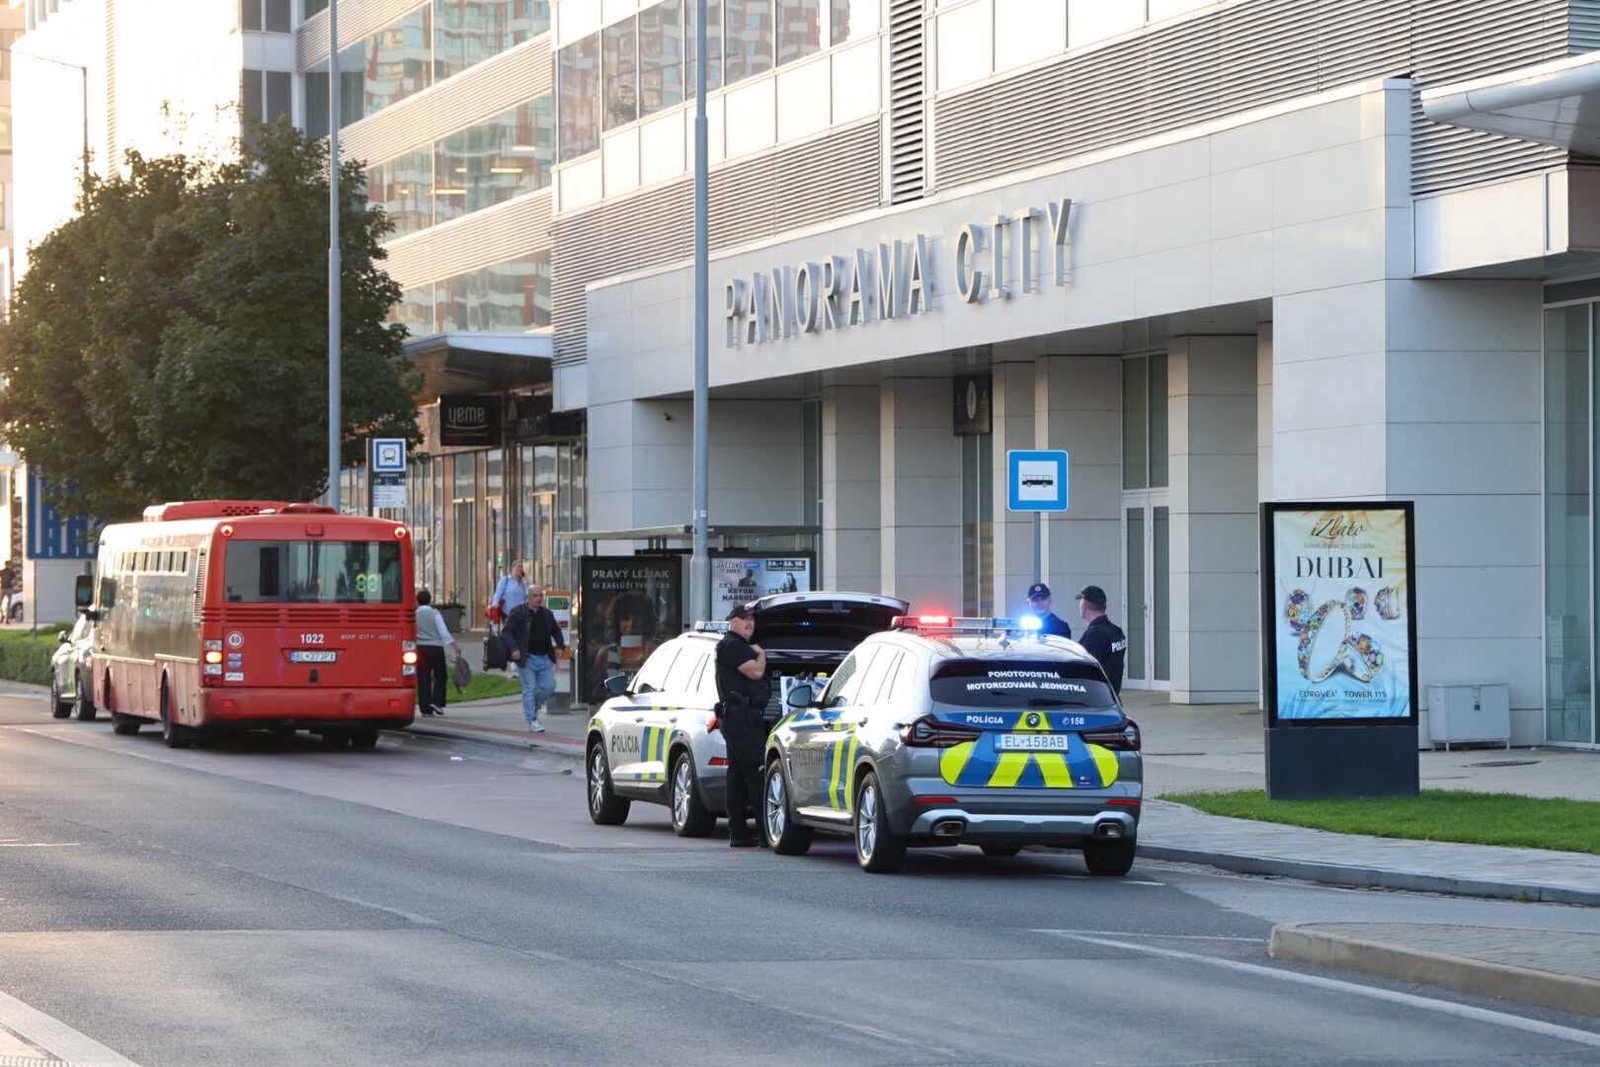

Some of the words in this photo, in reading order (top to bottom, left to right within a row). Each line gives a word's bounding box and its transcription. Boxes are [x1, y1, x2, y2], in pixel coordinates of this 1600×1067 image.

[726, 233, 933, 348] PANORAMA
[956, 198, 1072, 304] CITY
[448, 406, 485, 423] yeme
[1296, 556, 1383, 579] DUBAI
[300, 633, 325, 644] 1022
[1039, 682, 1087, 693] JEDNOTKA
[966, 714, 1004, 724] POLÍCIA
[1070, 717, 1085, 725] 158
